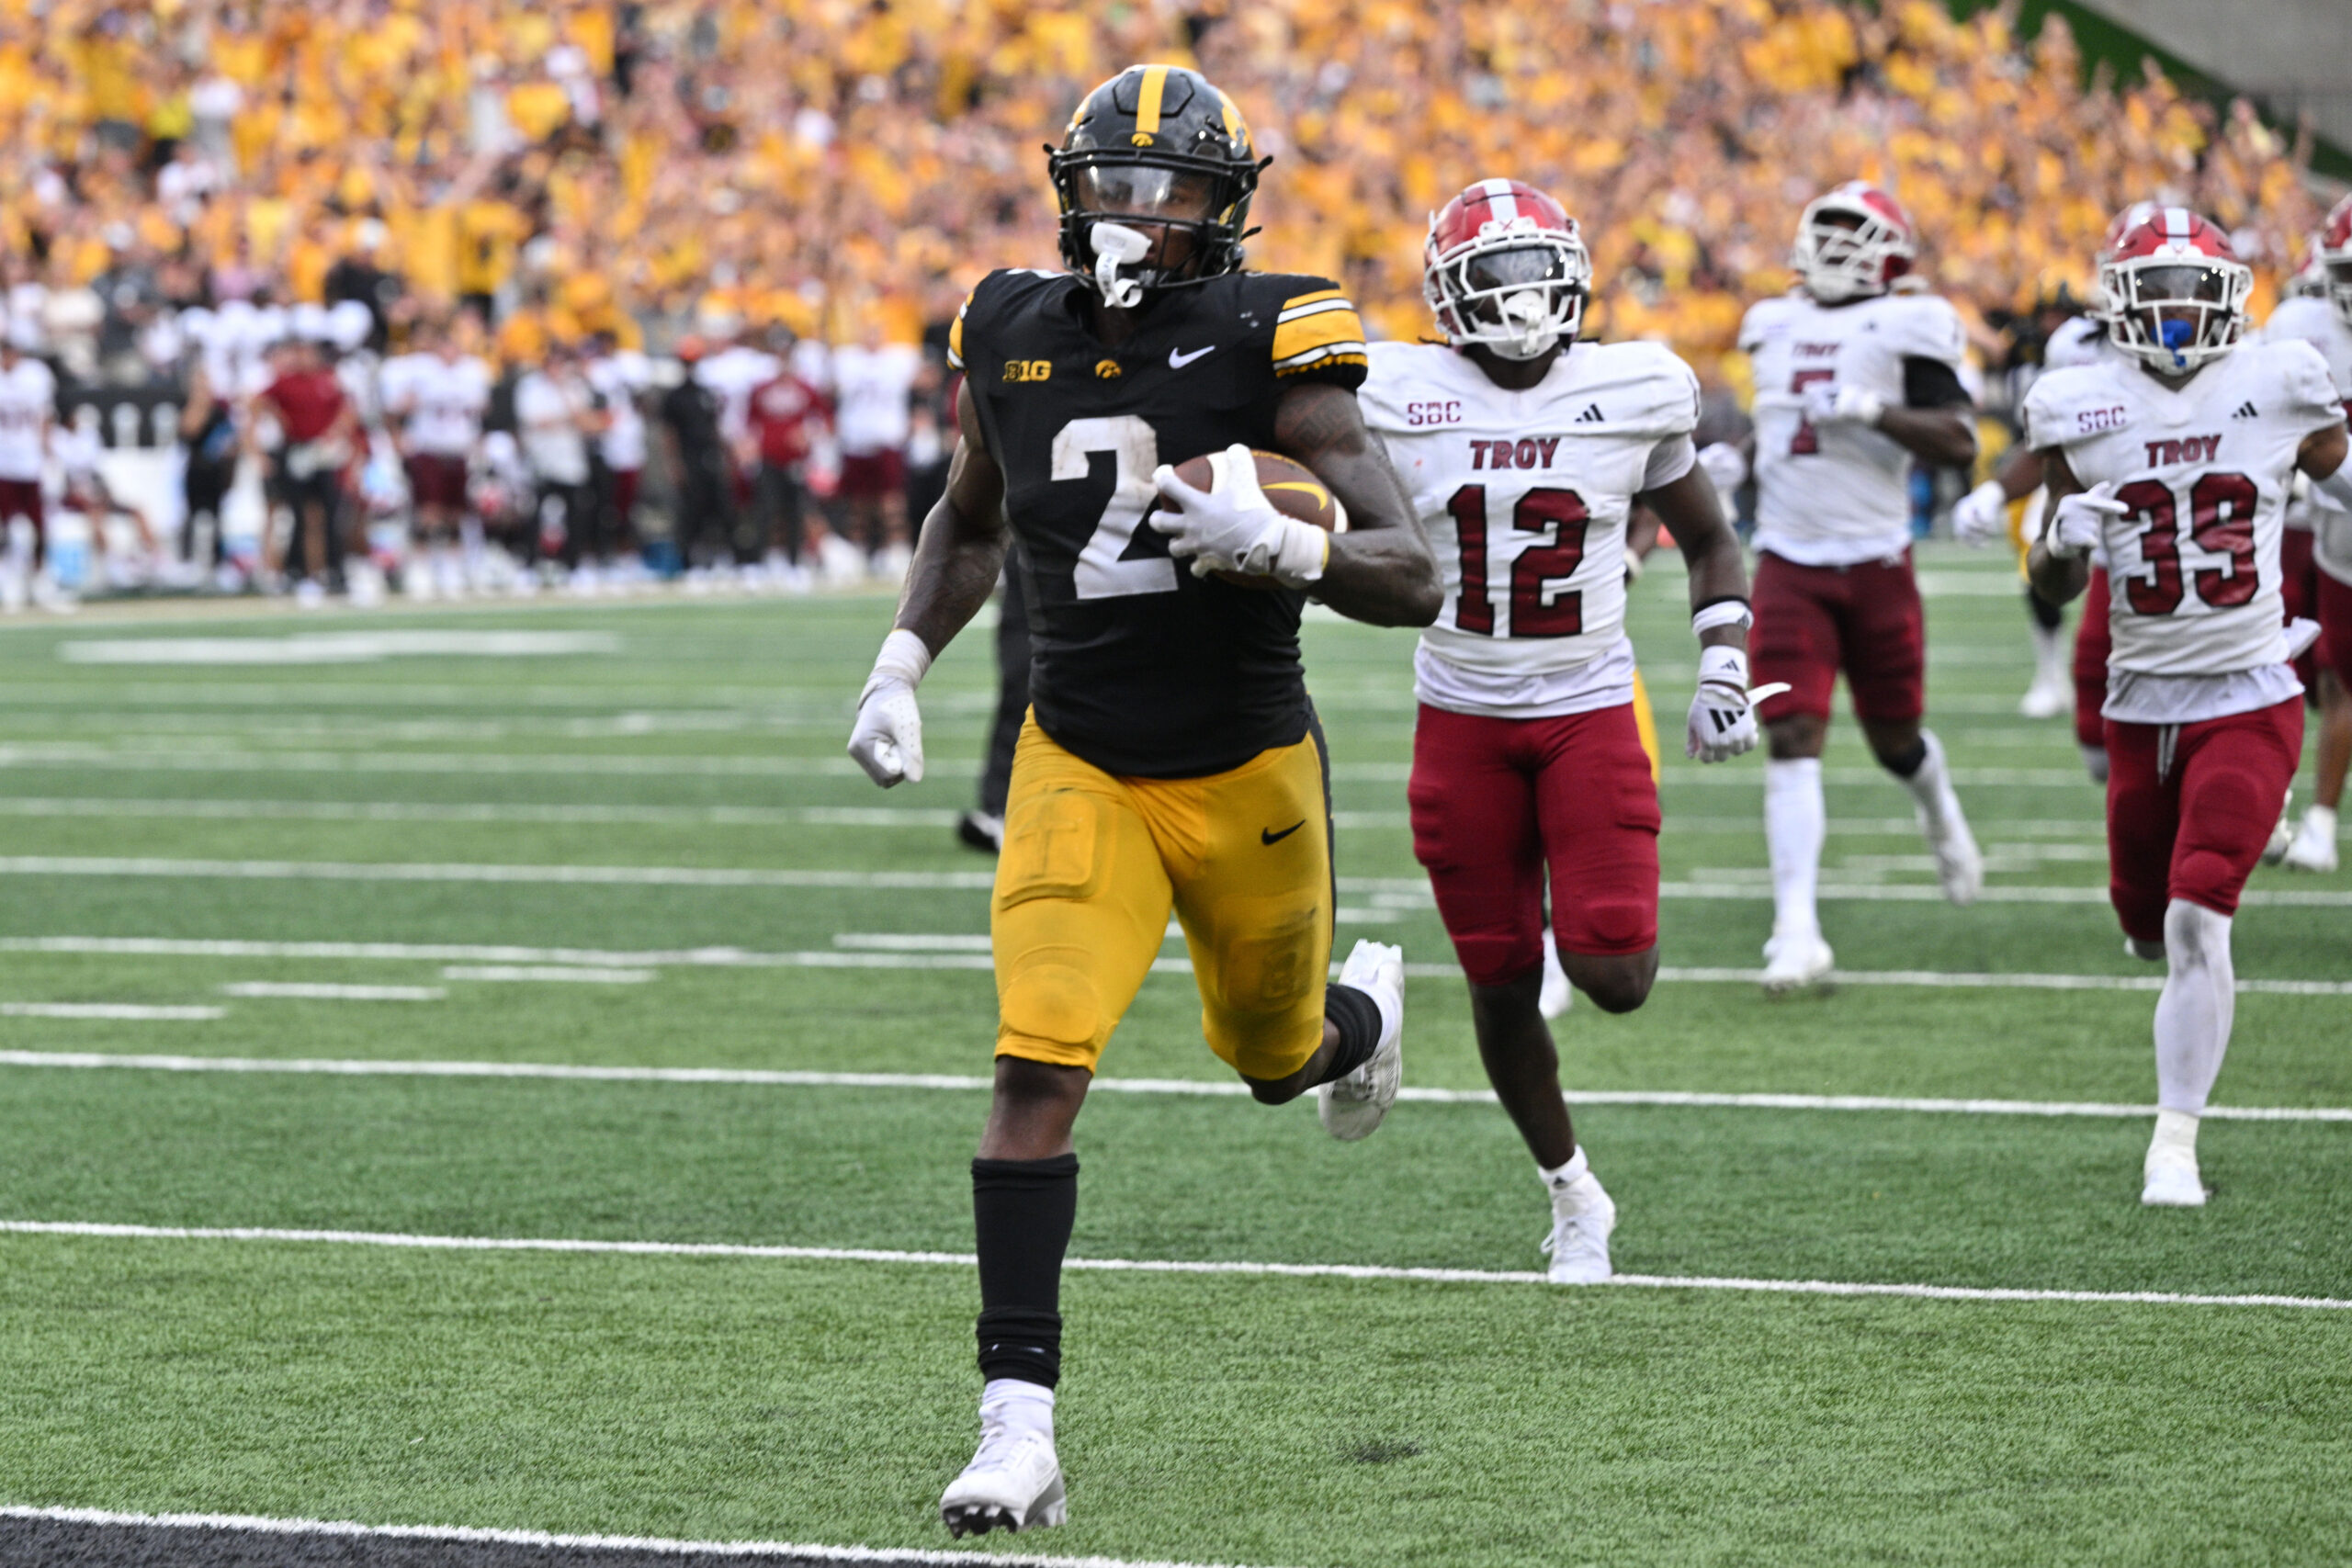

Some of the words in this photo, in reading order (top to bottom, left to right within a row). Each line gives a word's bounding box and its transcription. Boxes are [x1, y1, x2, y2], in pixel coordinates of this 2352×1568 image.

[1408, 400, 1461, 425] SBC
[1470, 436, 1561, 471] TROY
[2144, 434, 2222, 468] TROY
[1050, 414, 1180, 601] 2
[2114, 472, 2259, 615] 39
[1446, 483, 1591, 639] 12
